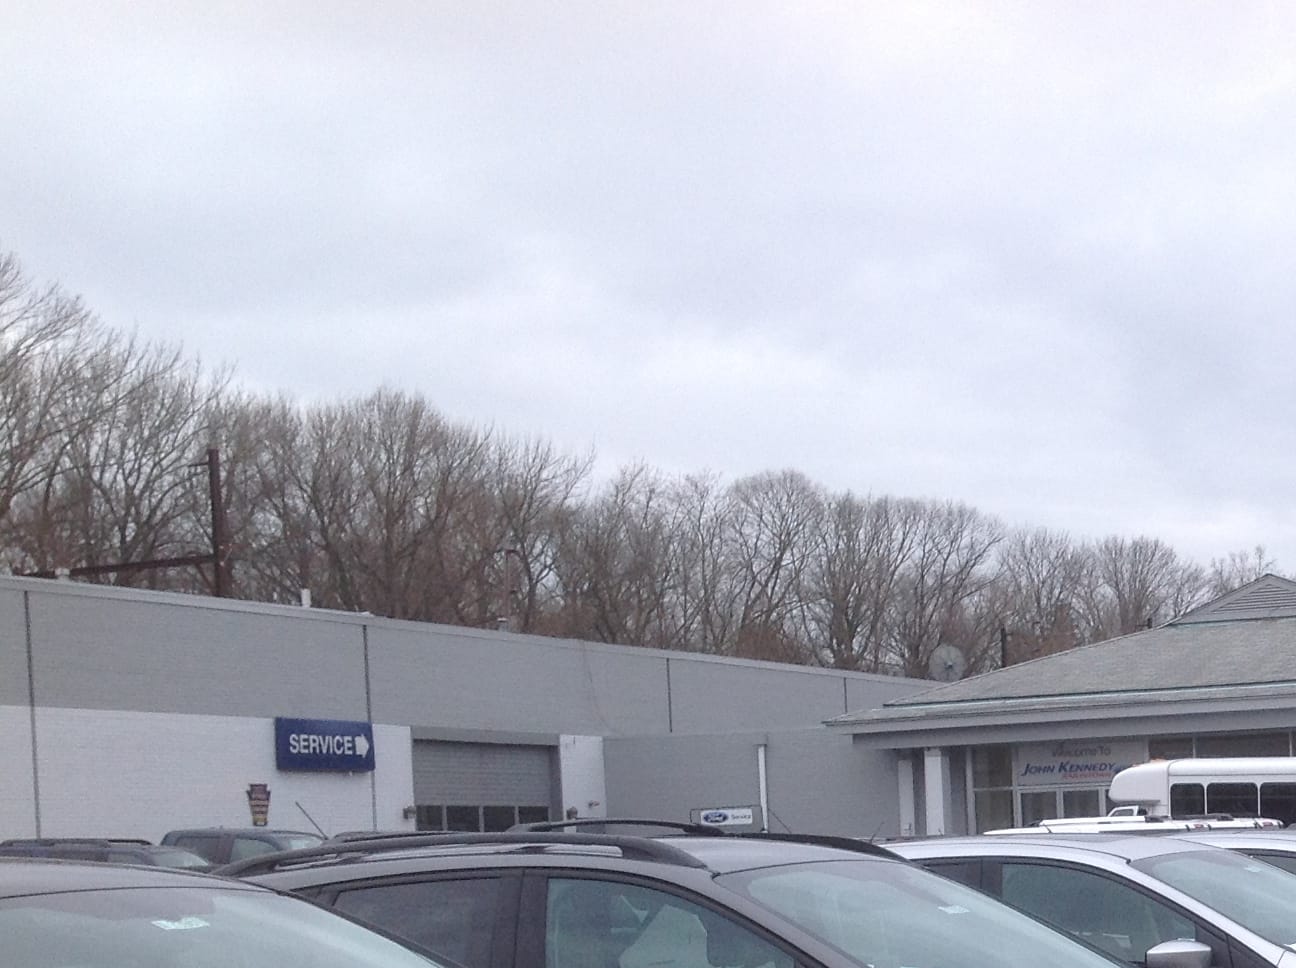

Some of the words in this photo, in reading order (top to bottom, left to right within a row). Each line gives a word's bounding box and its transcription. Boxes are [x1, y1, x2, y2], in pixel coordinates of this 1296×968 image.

[289, 733, 353, 755] SERVICE
[1021, 763, 1055, 776] JOHN
[1058, 761, 1116, 773] KENNEDY
